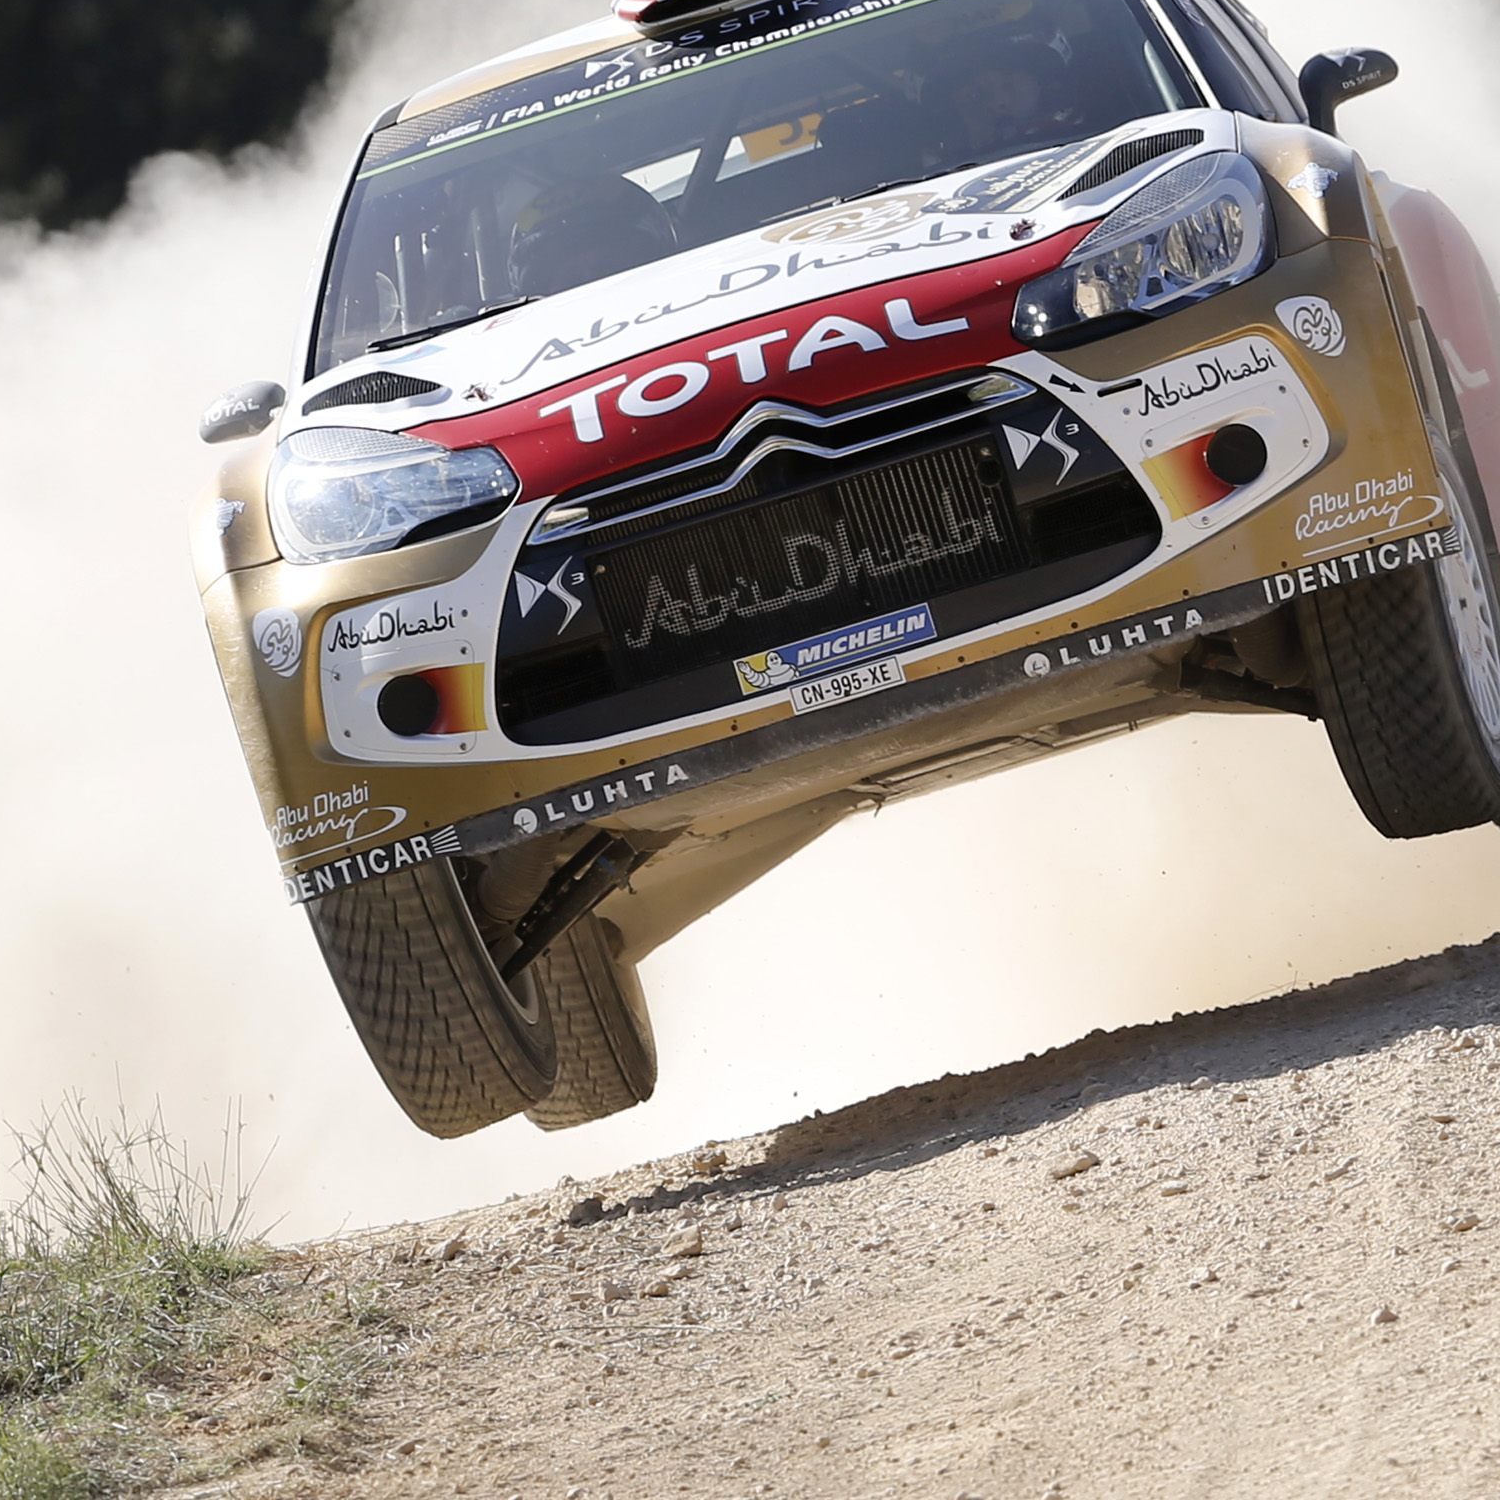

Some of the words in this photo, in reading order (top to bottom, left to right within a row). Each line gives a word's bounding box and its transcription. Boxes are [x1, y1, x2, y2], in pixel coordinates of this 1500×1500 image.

[645, 30, 705, 58] DS
[501, 100, 545, 124] FIA
[553, 74, 630, 107] World
[639, 51, 707, 80] Rally
[1342, 78, 1356, 90] DS
[1355, 69, 1382, 85] SPIRIT
[538, 297, 971, 443] TOTAL
[203, 398, 260, 427] TOTAL
[1294, 495, 1415, 541] Racing
[1309, 492, 1350, 517] Abu
[1355, 468, 1414, 504] Dhabi
[1262, 531, 1445, 605] IDENTICAR
[797, 612, 927, 666] MICHELIN
[1059, 608, 1204, 666] LUHTA
[801, 663, 892, 706] CN-995-XE
[276, 806, 309, 829] Abu
[313, 780, 370, 819] Dhabi
[544, 763, 690, 823] LUHTA
[283, 835, 433, 902] DENTICAR
